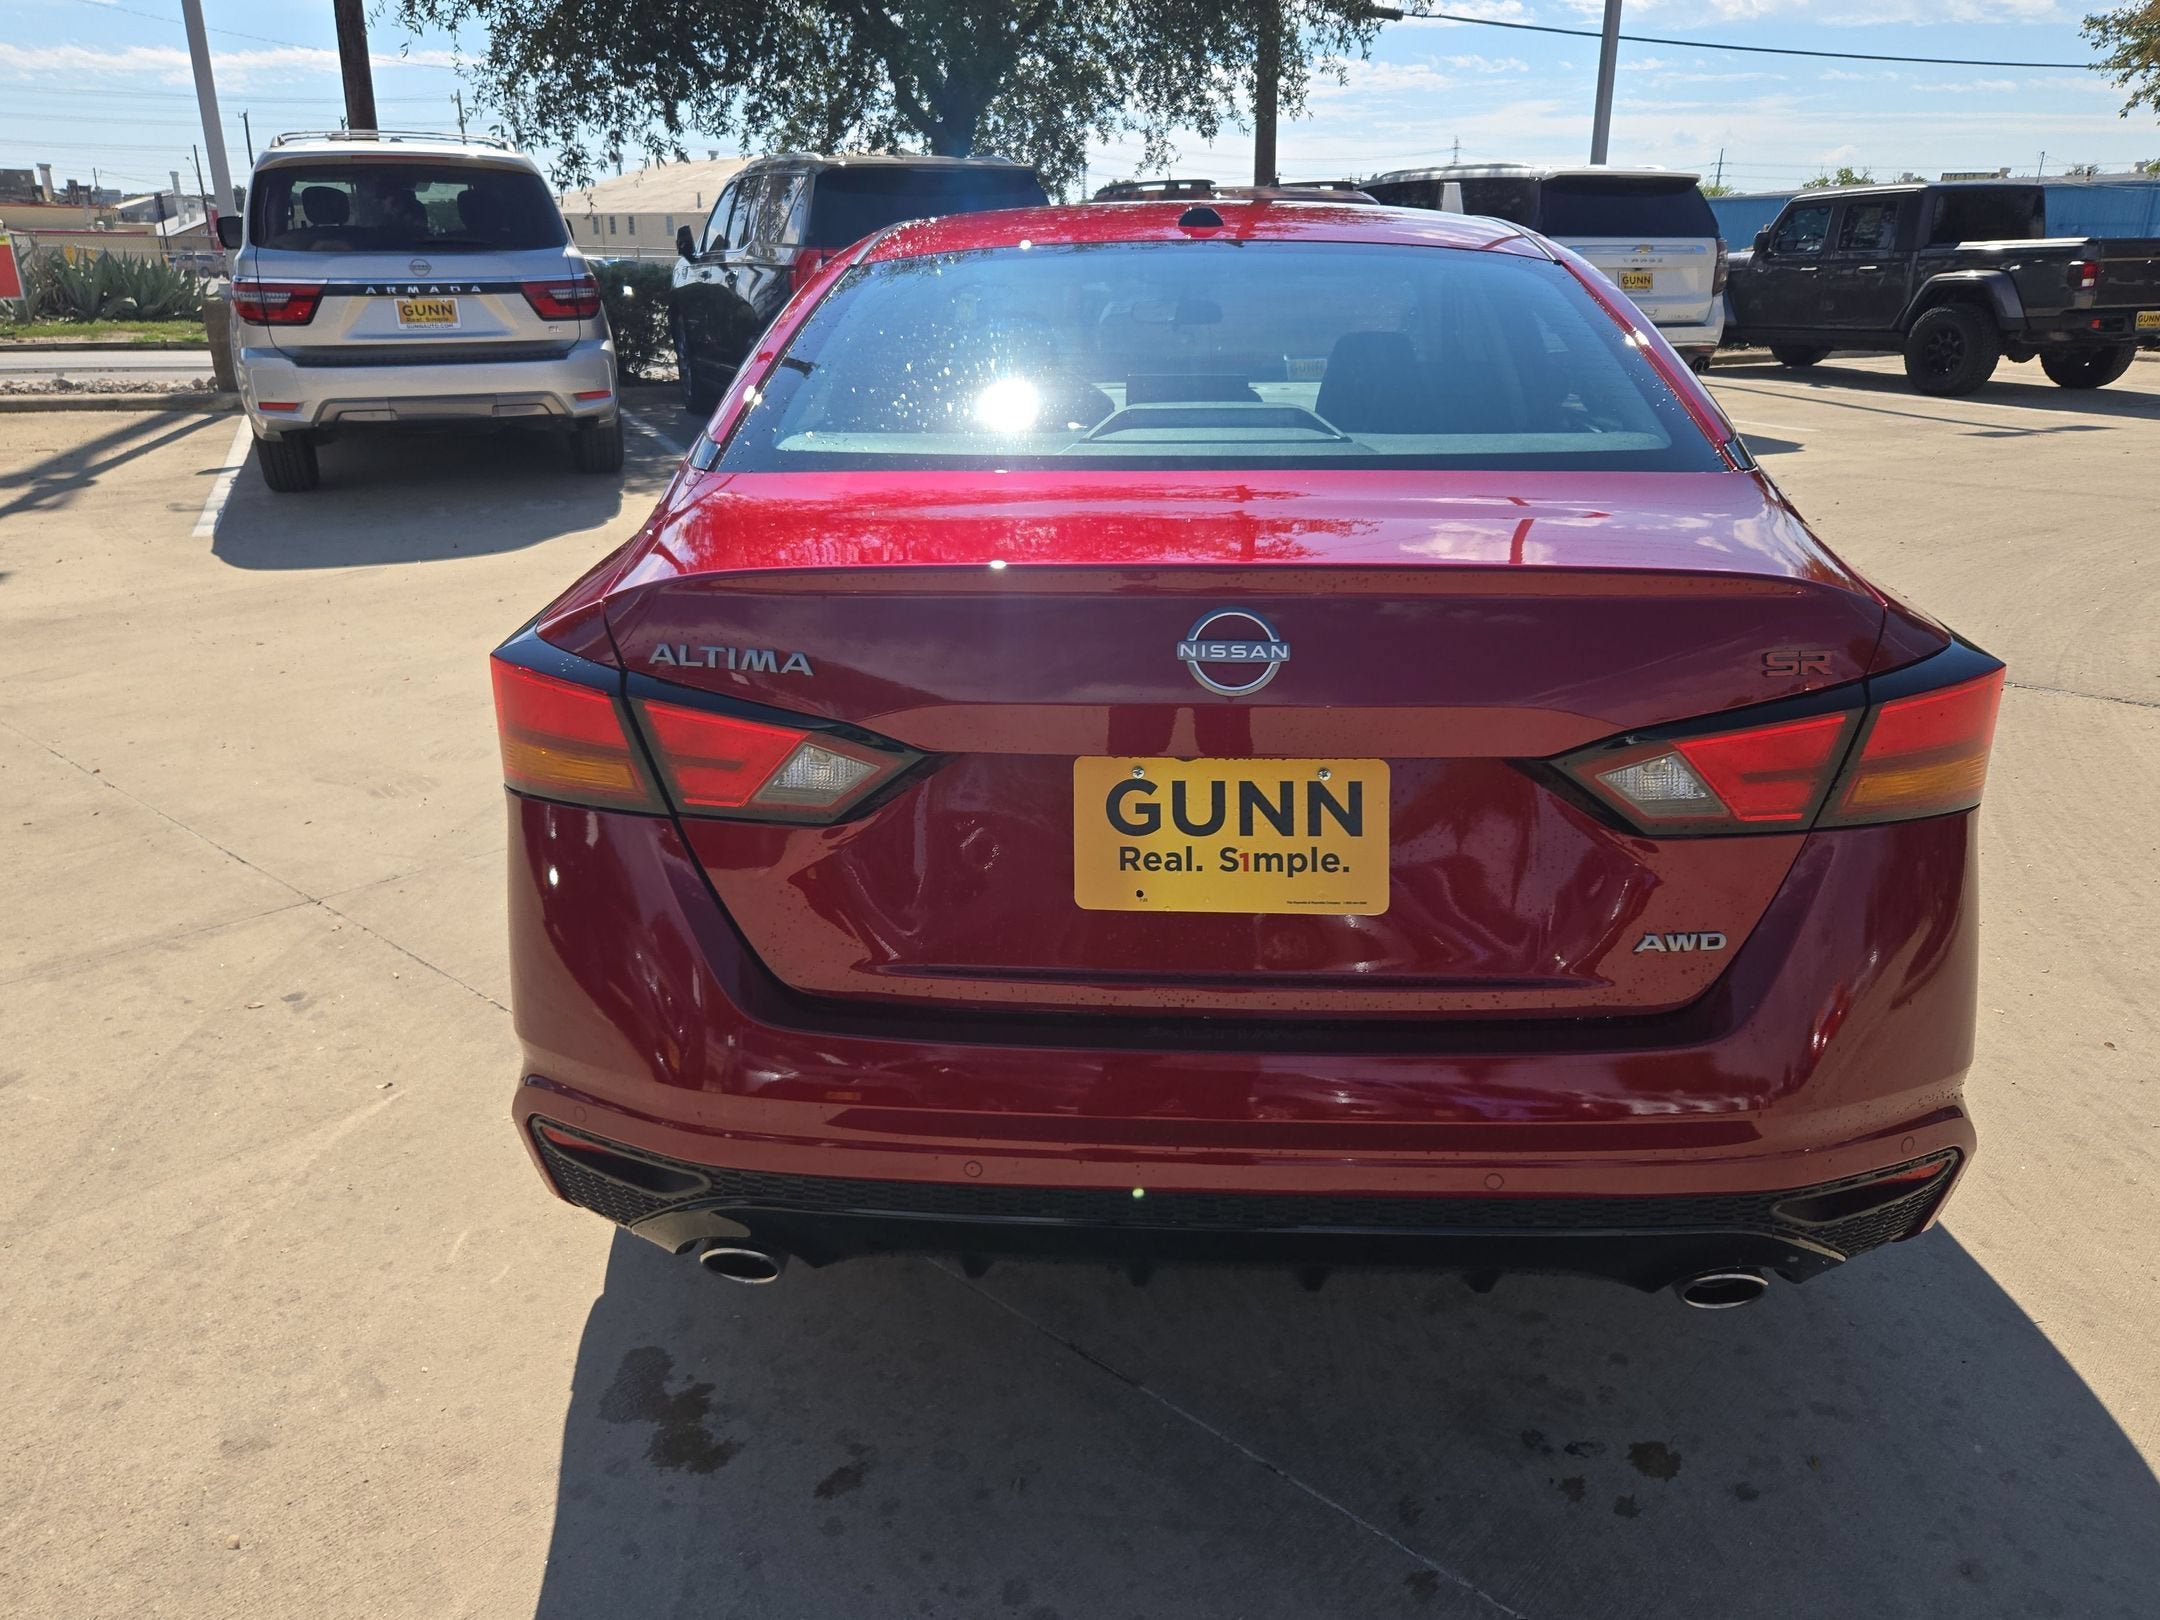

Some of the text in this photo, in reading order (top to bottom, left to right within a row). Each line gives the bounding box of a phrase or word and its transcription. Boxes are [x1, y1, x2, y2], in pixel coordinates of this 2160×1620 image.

[365, 285, 481, 295] ARMADA
[1622, 276, 1651, 285] GUNN
[402, 304, 453, 317] GUNN
[648, 643, 814, 677] ALTIMA
[1180, 644, 1288, 659] NISSAN
[1761, 651, 1833, 676] SR
[1105, 778, 1363, 837] GUNN
[1119, 846, 1203, 872] Real.
[1632, 930, 1727, 954] AWD
